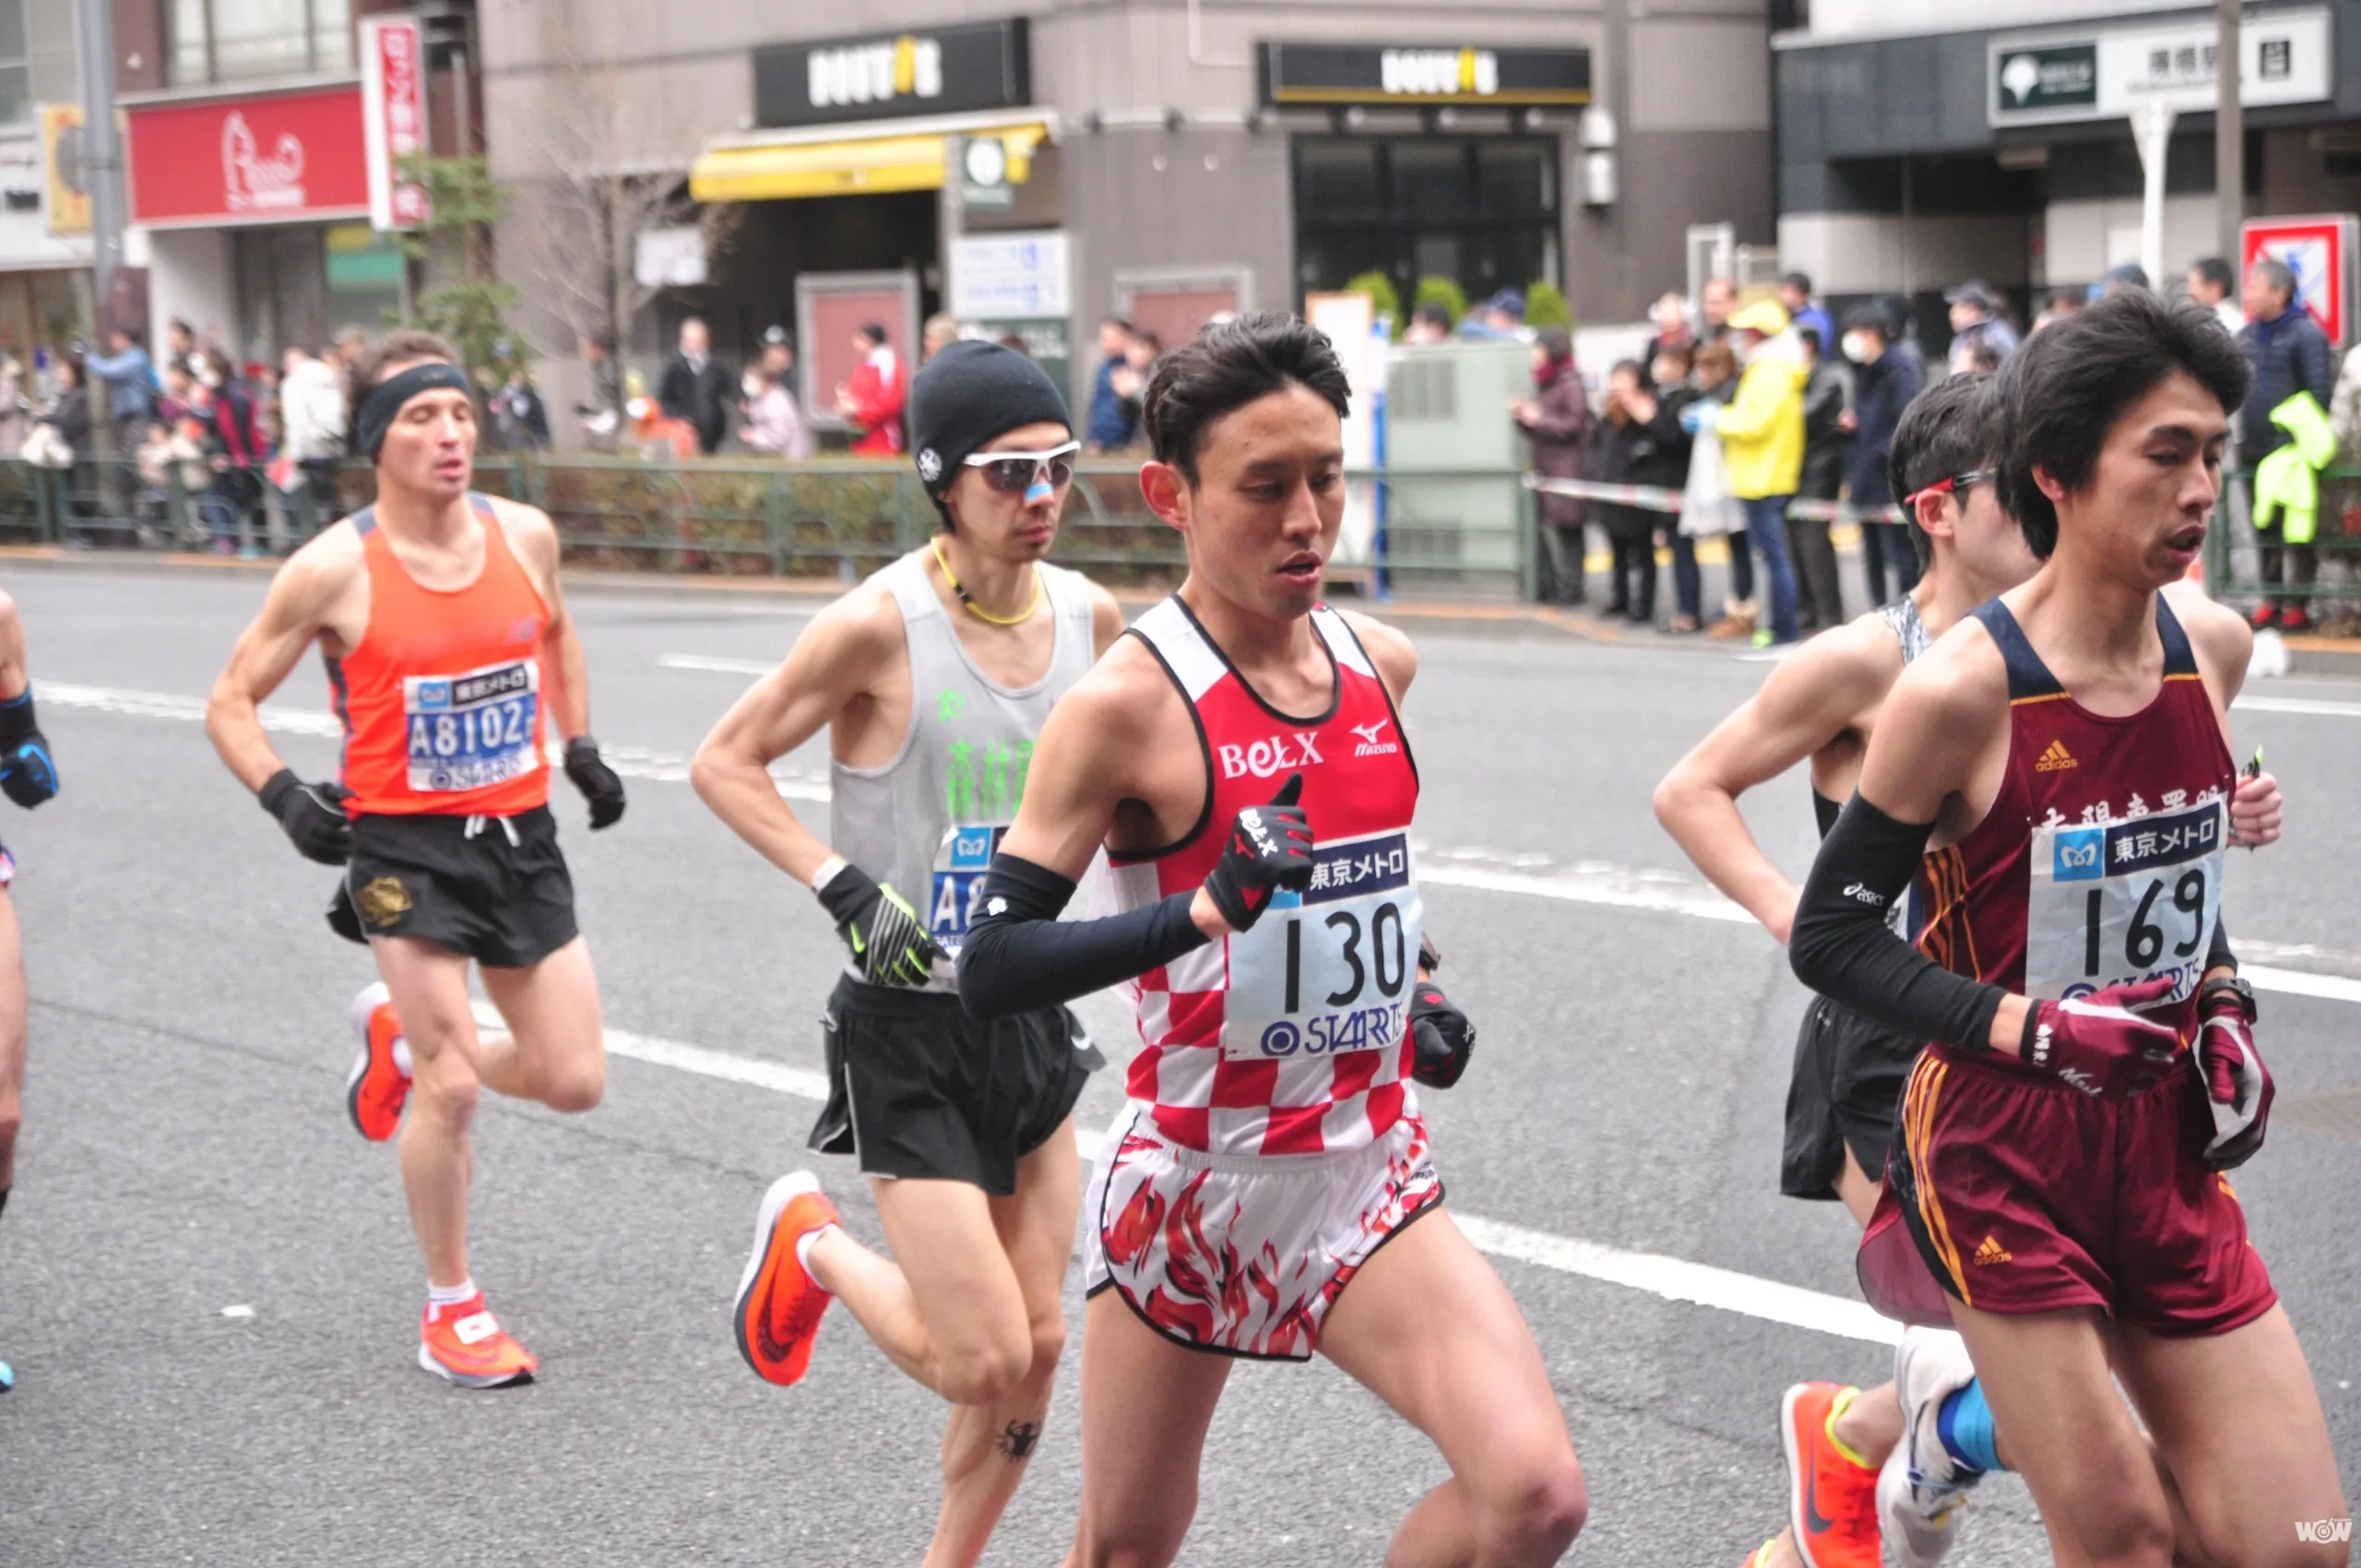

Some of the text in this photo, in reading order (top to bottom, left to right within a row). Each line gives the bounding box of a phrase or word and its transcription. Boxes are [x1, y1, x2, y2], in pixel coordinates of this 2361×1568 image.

[409, 702, 524, 757] A8102
[2035, 757, 2078, 773] adidas
[2114, 817, 2215, 863] 東京メトロ
[1310, 848, 1405, 892] 東京メトロ
[1857, 888, 1885, 907] asics
[2085, 868, 2205, 978] 169
[1285, 901, 1406, 1015] 130
[1973, 1252, 2012, 1266] adidas
